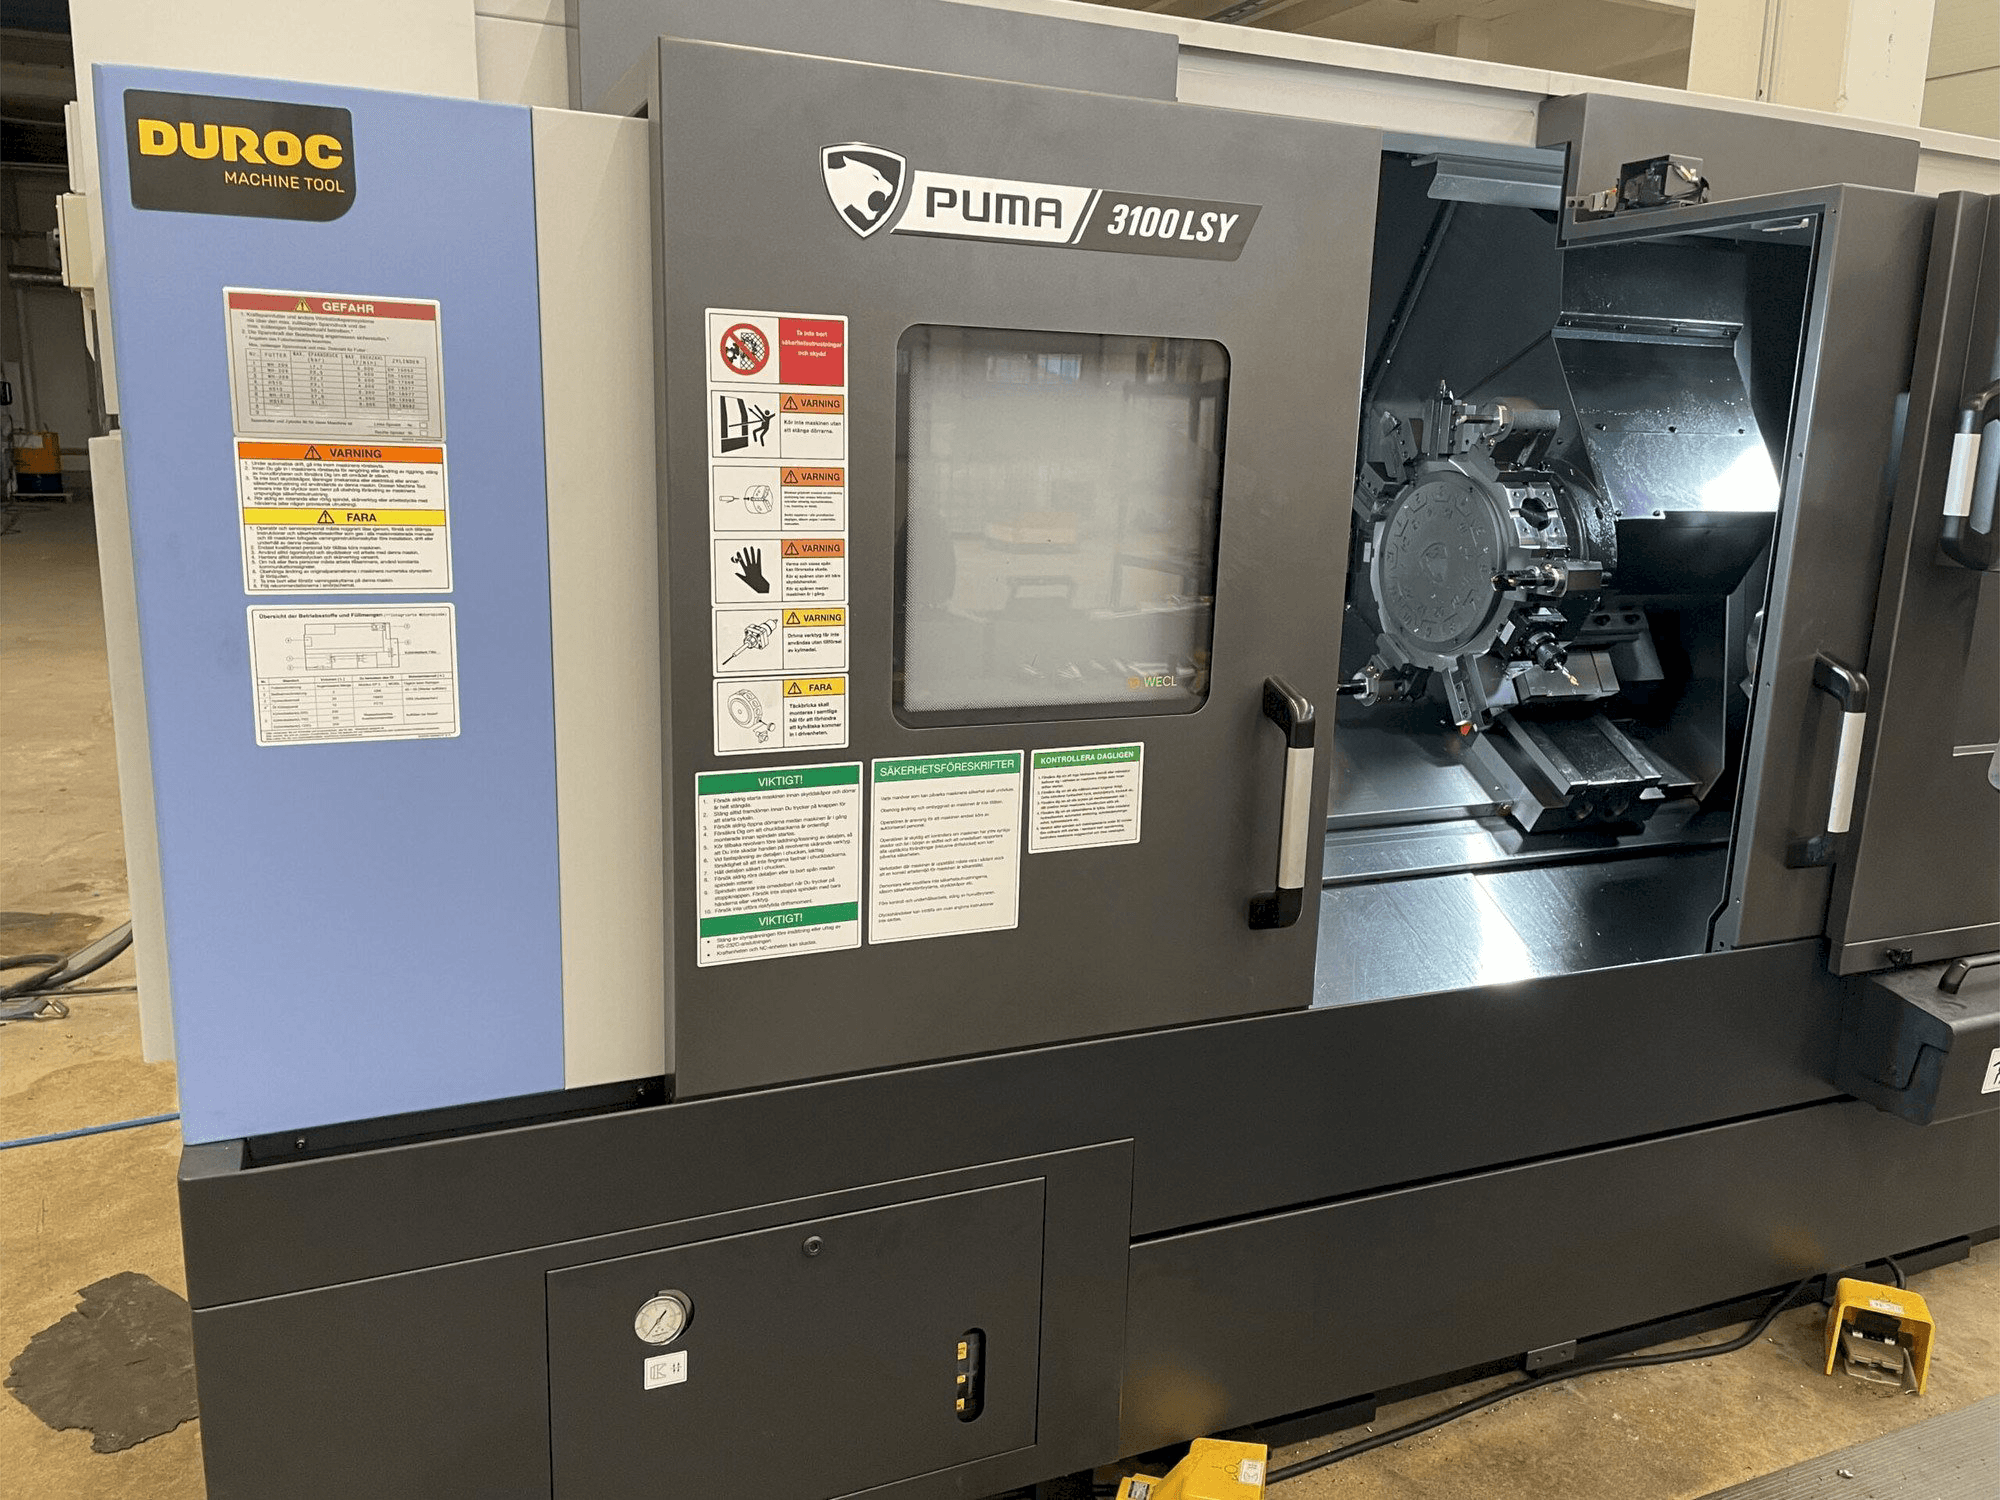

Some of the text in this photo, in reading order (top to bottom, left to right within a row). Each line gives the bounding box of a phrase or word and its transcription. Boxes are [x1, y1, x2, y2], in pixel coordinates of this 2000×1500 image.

[138, 118, 343, 170] DUROC
[224, 170, 345, 193] MACHINE TOOL
[926, 186, 1063, 229] PUMA
[322, 301, 375, 314] GEFAHR
[800, 399, 840, 408] VARNING
[329, 448, 382, 459] VARNING
[801, 472, 840, 481] VARNING
[346, 512, 377, 523] FARA
[802, 544, 841, 553] VARNING
[803, 613, 842, 622] VARNING
[808, 683, 833, 692] FARA
[1040, 750, 1134, 765] KONTROLLERA DAGLIGEN
[880, 759, 1014, 777] SÄKERHETSFÖRESKRIFTER
[757, 775, 803, 787] VIKTIGT!
[758, 913, 803, 926] VIKTIGT!
